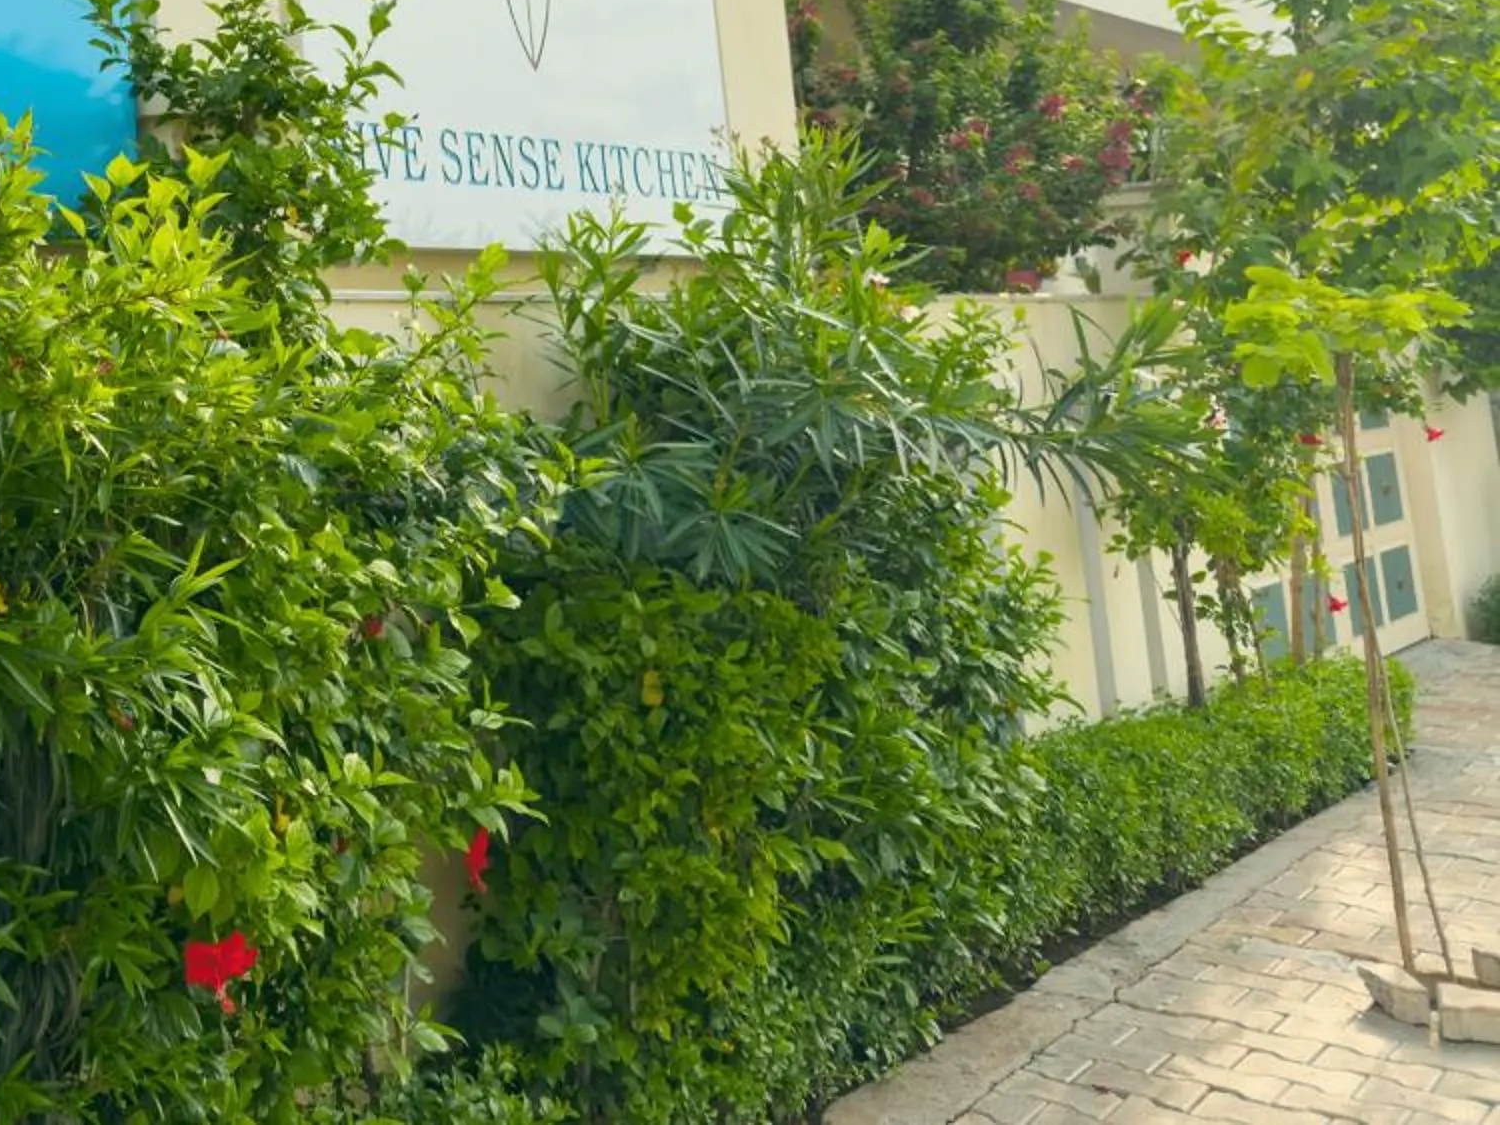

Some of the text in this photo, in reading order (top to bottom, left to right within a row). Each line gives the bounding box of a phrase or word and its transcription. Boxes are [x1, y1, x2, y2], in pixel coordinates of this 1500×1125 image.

[336, 121, 721, 201] IVE SENSE KITCHEN
